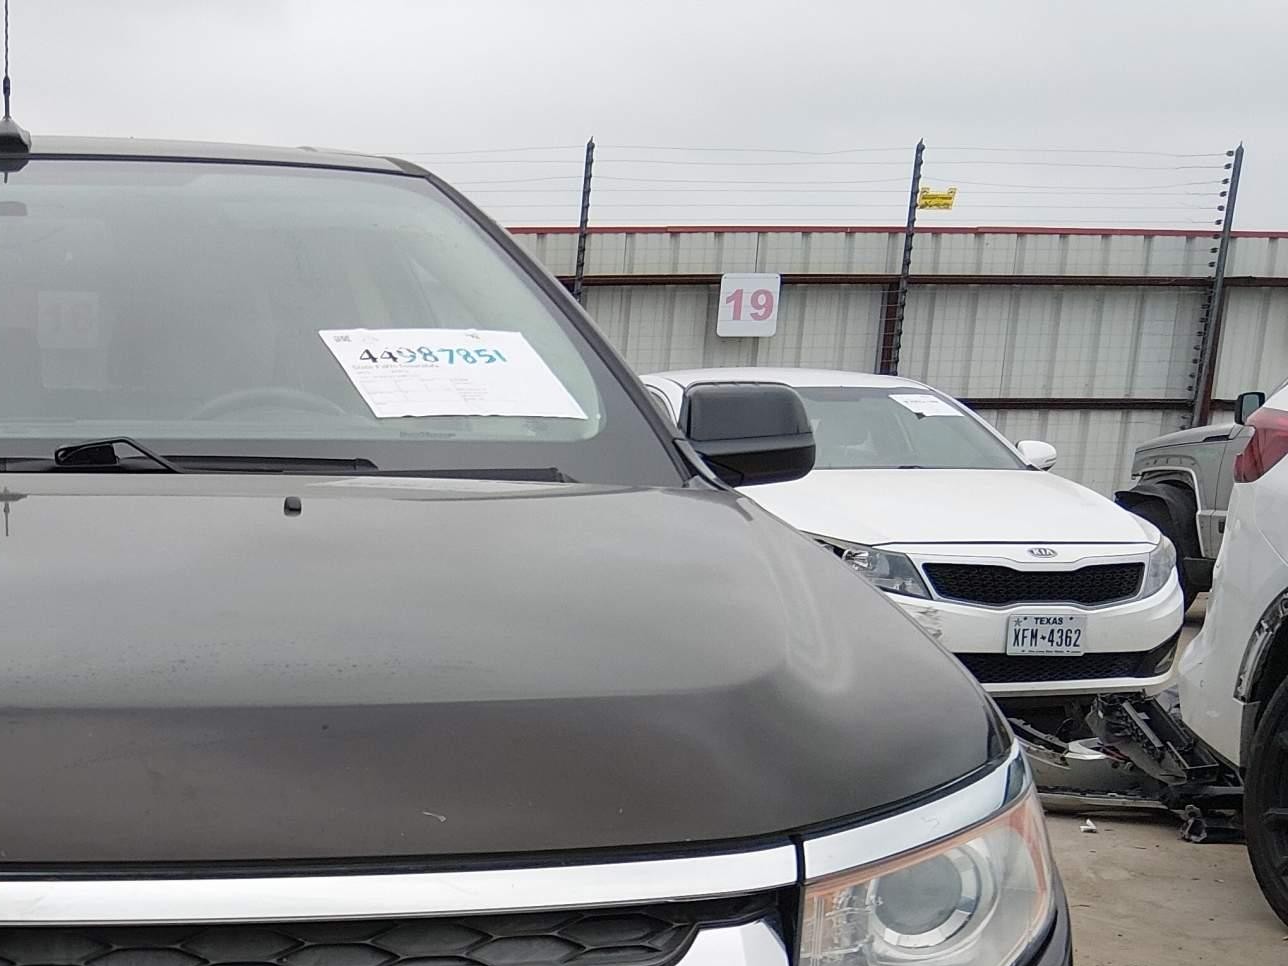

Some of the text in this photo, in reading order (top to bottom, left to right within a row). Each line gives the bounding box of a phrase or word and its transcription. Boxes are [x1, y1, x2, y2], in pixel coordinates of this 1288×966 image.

[725, 288, 774, 321] 19
[359, 346, 508, 365] 44987851
[1034, 617, 1063, 625] TEXAS
